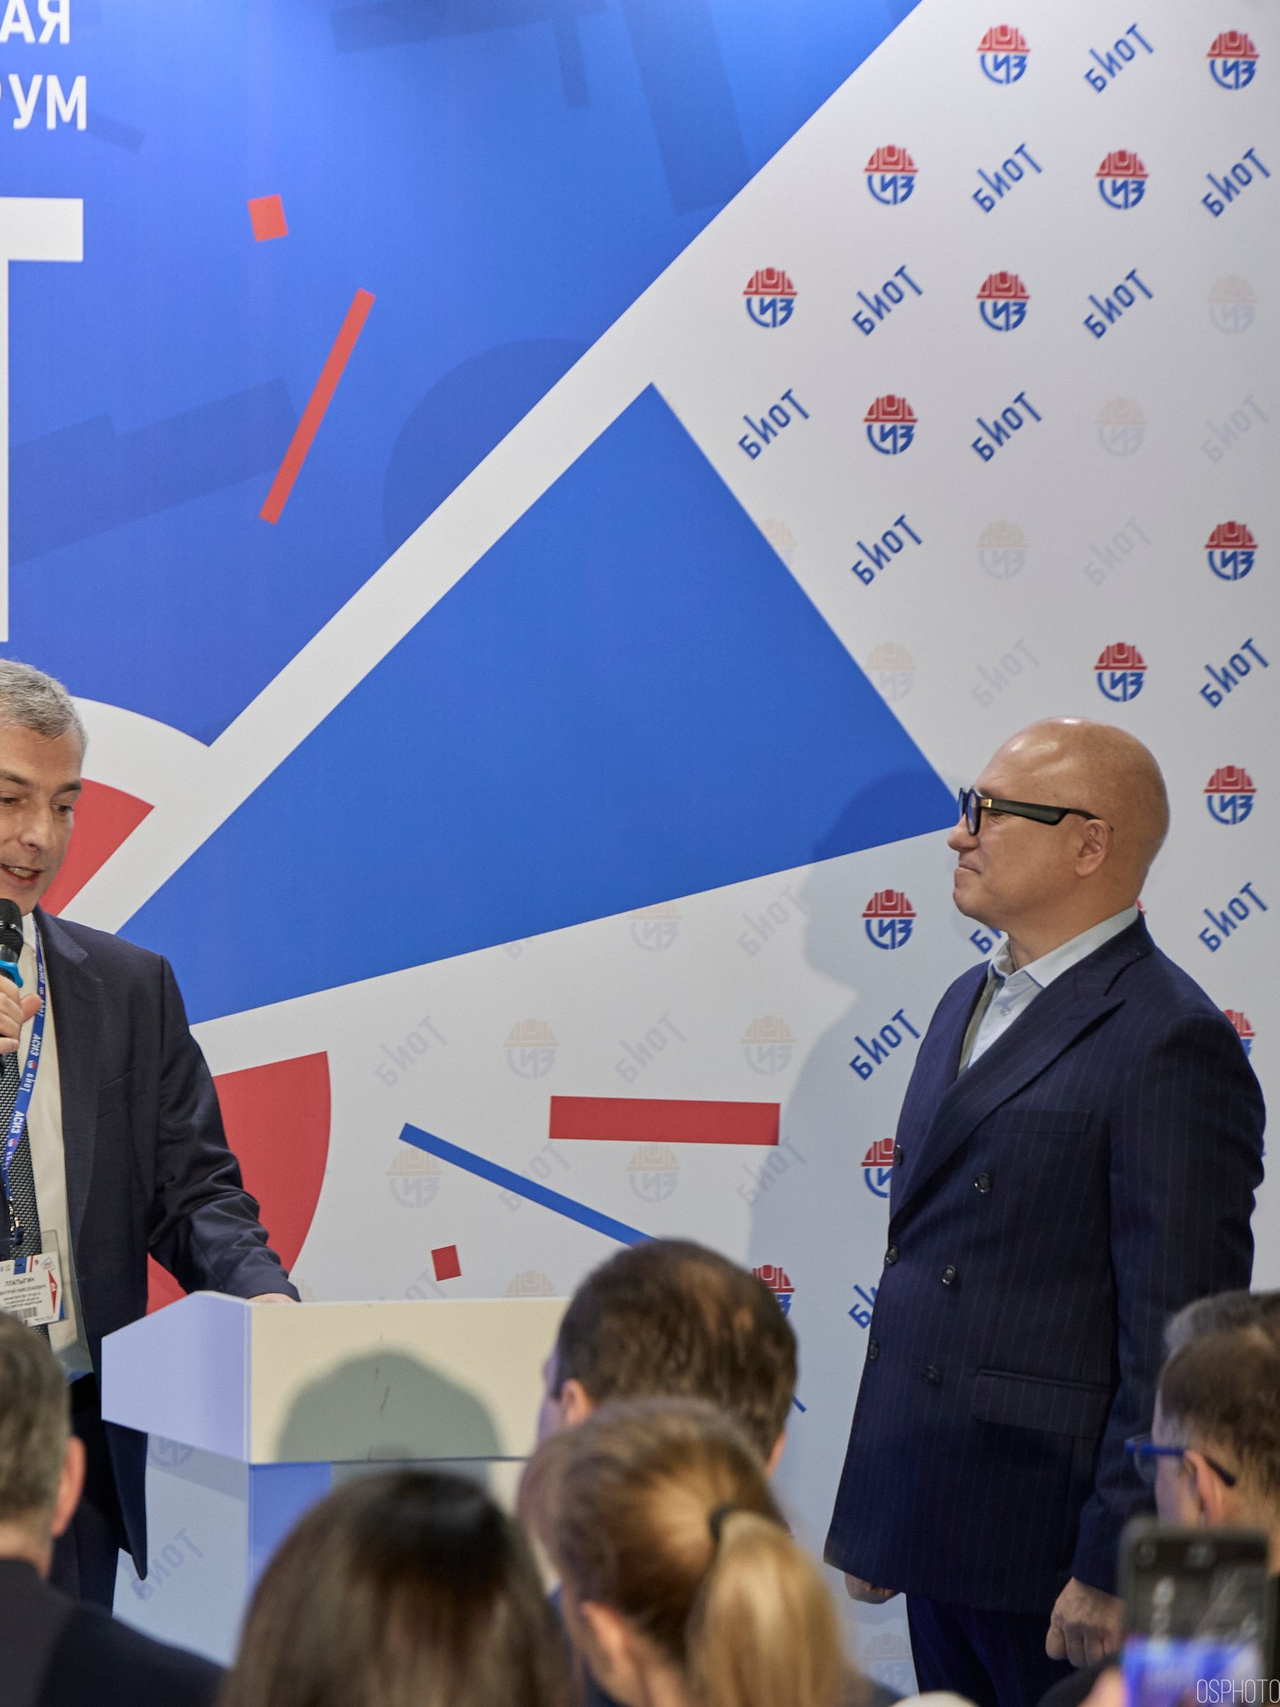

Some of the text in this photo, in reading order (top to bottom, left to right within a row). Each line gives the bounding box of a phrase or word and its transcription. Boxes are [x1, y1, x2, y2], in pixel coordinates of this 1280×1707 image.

[1084, 23, 1154, 93] БИОТ
[972, 143, 1043, 213] БИОТ
[1201, 147, 1271, 218] БИОТ
[852, 265, 924, 336] БИОТ
[1083, 268, 1154, 339] БИОТ
[737, 388, 810, 460] БИОТ
[971, 391, 1043, 462] БИОТ
[851, 514, 923, 586] БИОТ
[1199, 637, 1270, 709] БИОТ
[1198, 881, 1269, 953] БИОТ
[849, 1008, 921, 1081] БИОТ
[10, 1110, 25, 1134] АСИЗ
[498, 1140, 572, 1213] БОТ
